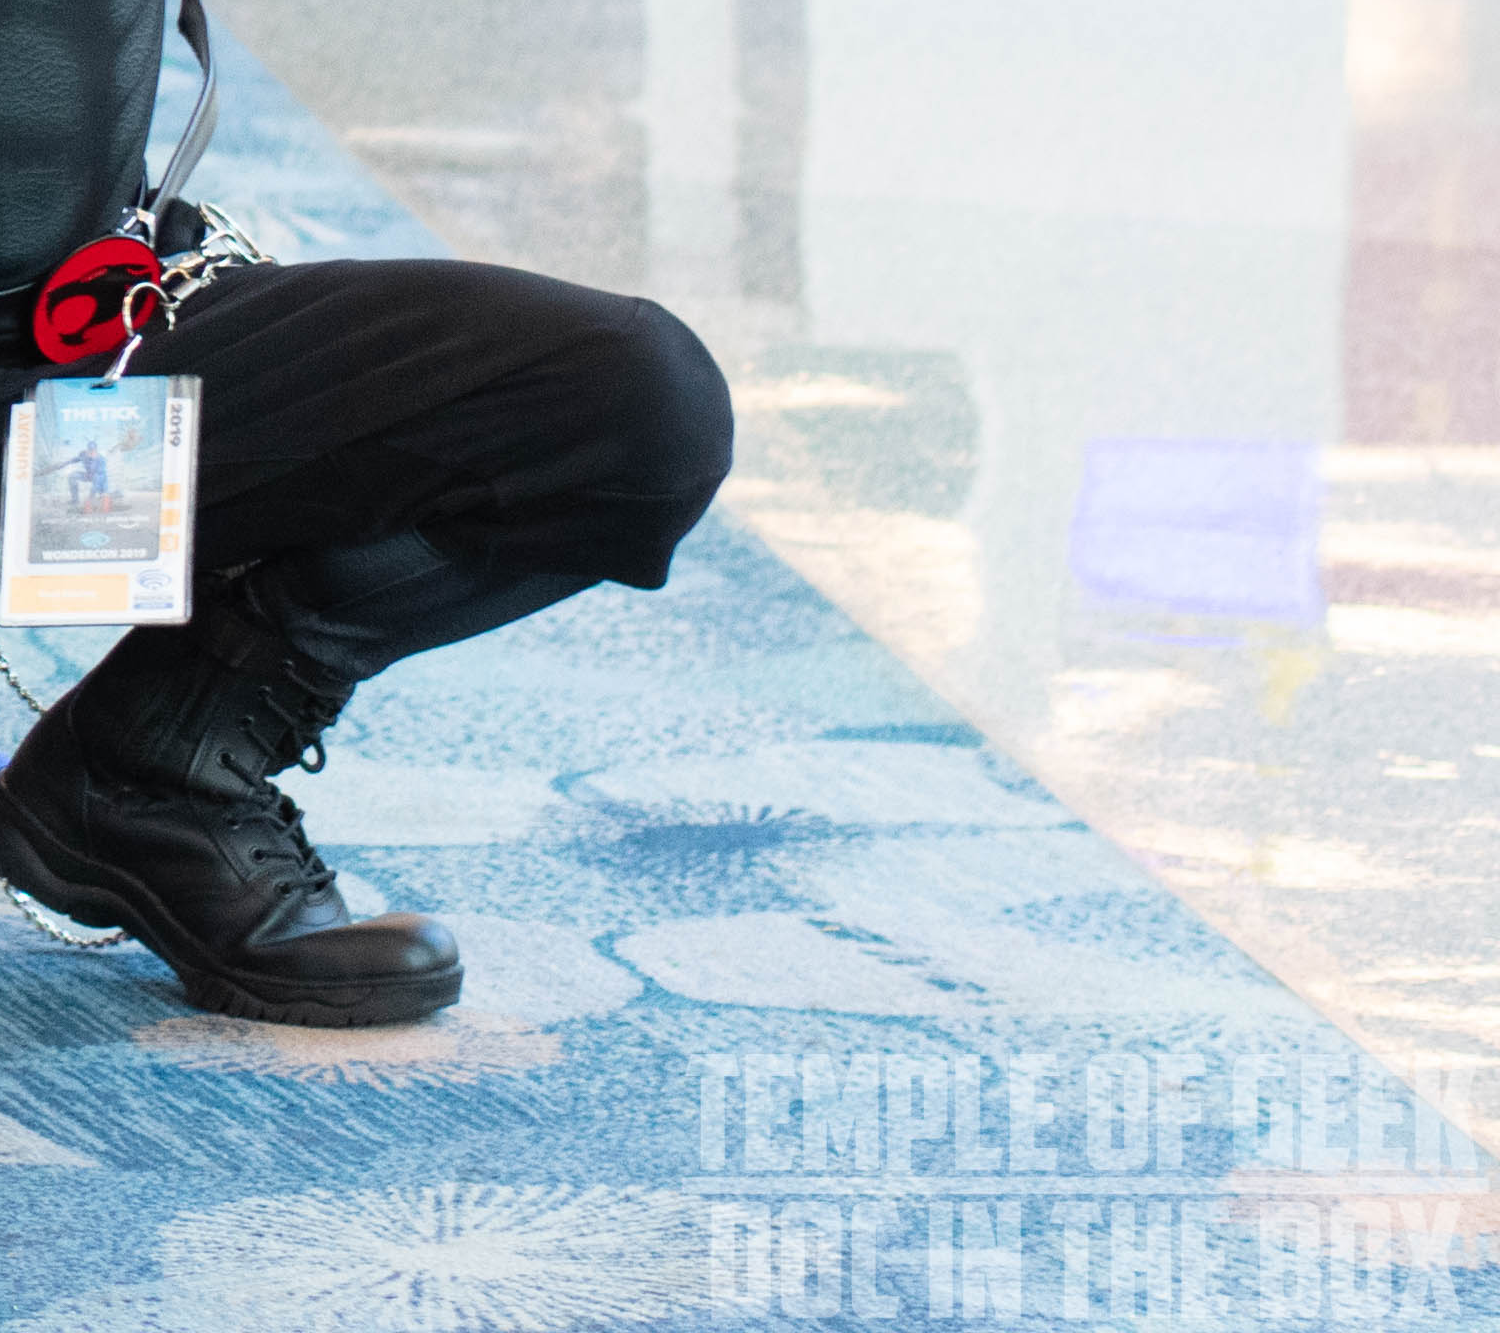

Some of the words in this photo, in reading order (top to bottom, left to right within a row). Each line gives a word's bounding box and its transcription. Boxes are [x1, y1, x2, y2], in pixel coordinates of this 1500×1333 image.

[60, 408, 97, 422] THE
[99, 405, 141, 422] TICK
[169, 403, 183, 448] 2019
[41, 549, 118, 561] WONDERCON
